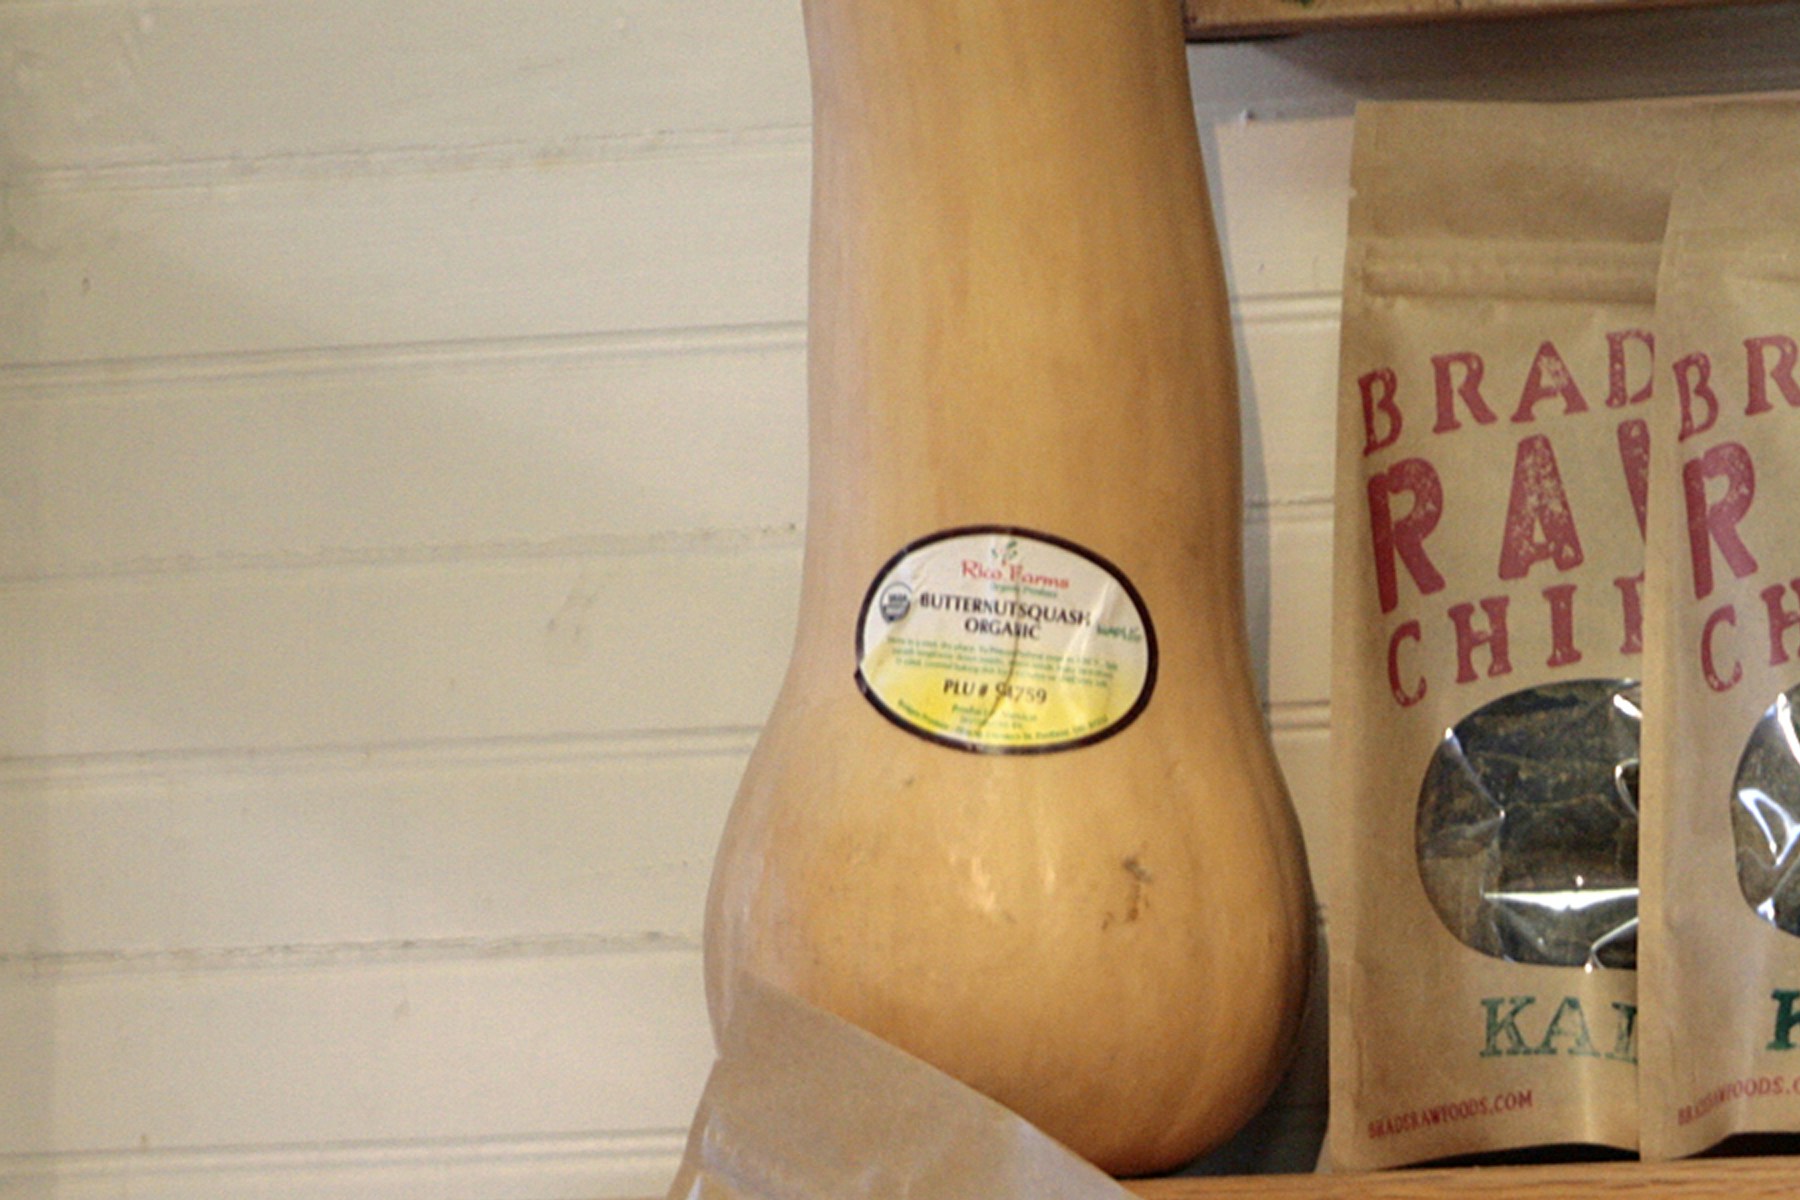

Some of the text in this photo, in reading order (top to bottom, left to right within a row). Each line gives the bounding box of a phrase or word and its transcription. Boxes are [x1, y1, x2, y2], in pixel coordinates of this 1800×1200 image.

[1358, 329, 1655, 458] BRAD
[960, 559, 1070, 590] Rico Farms
[944, 678, 975, 697] PLU
